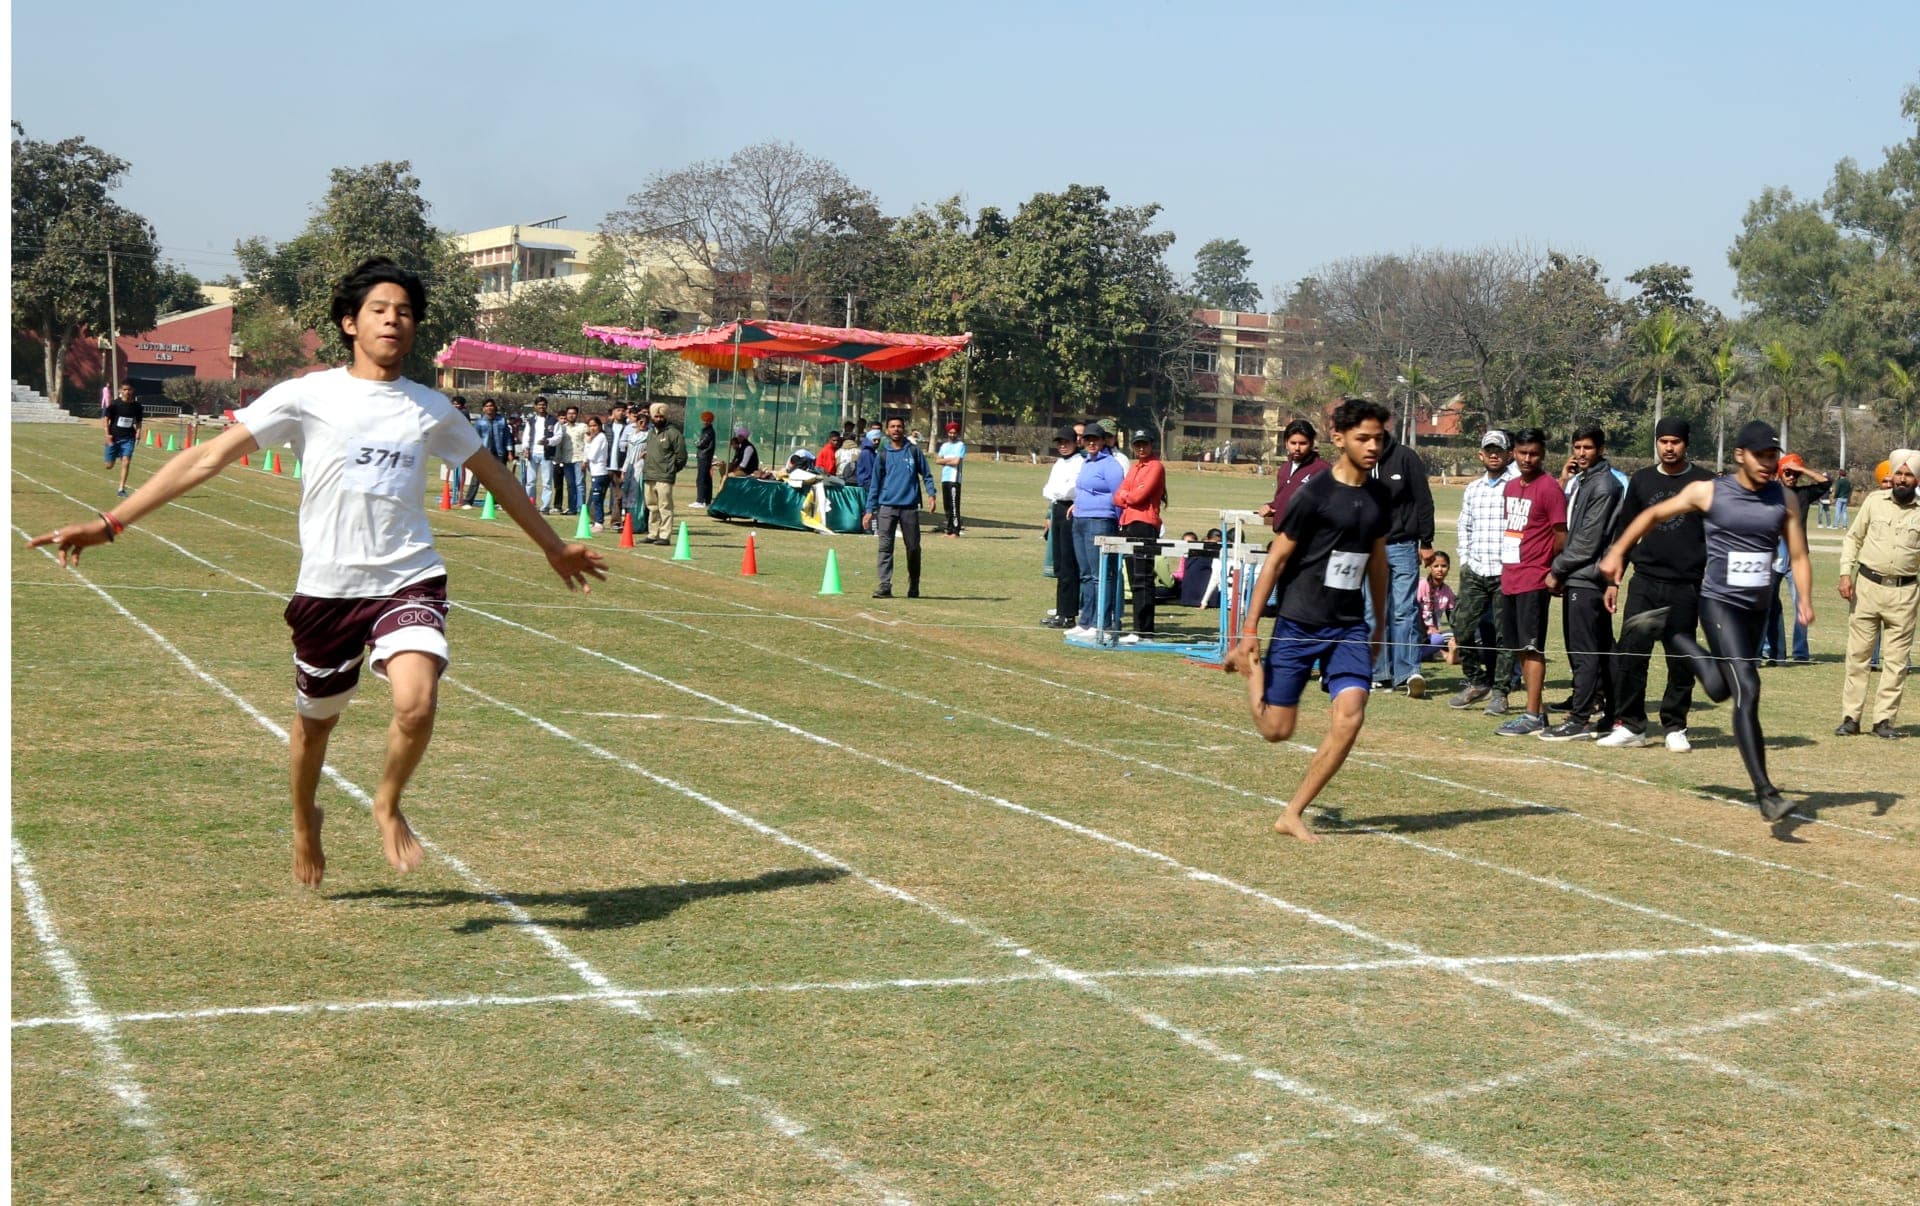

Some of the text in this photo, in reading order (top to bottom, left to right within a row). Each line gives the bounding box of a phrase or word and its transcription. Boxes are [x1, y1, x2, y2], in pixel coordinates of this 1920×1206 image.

[155, 351, 173, 361] LAB
[355, 447, 401, 469] 371
[1333, 562, 1360, 578] 141
[1731, 560, 1763, 574] 222
